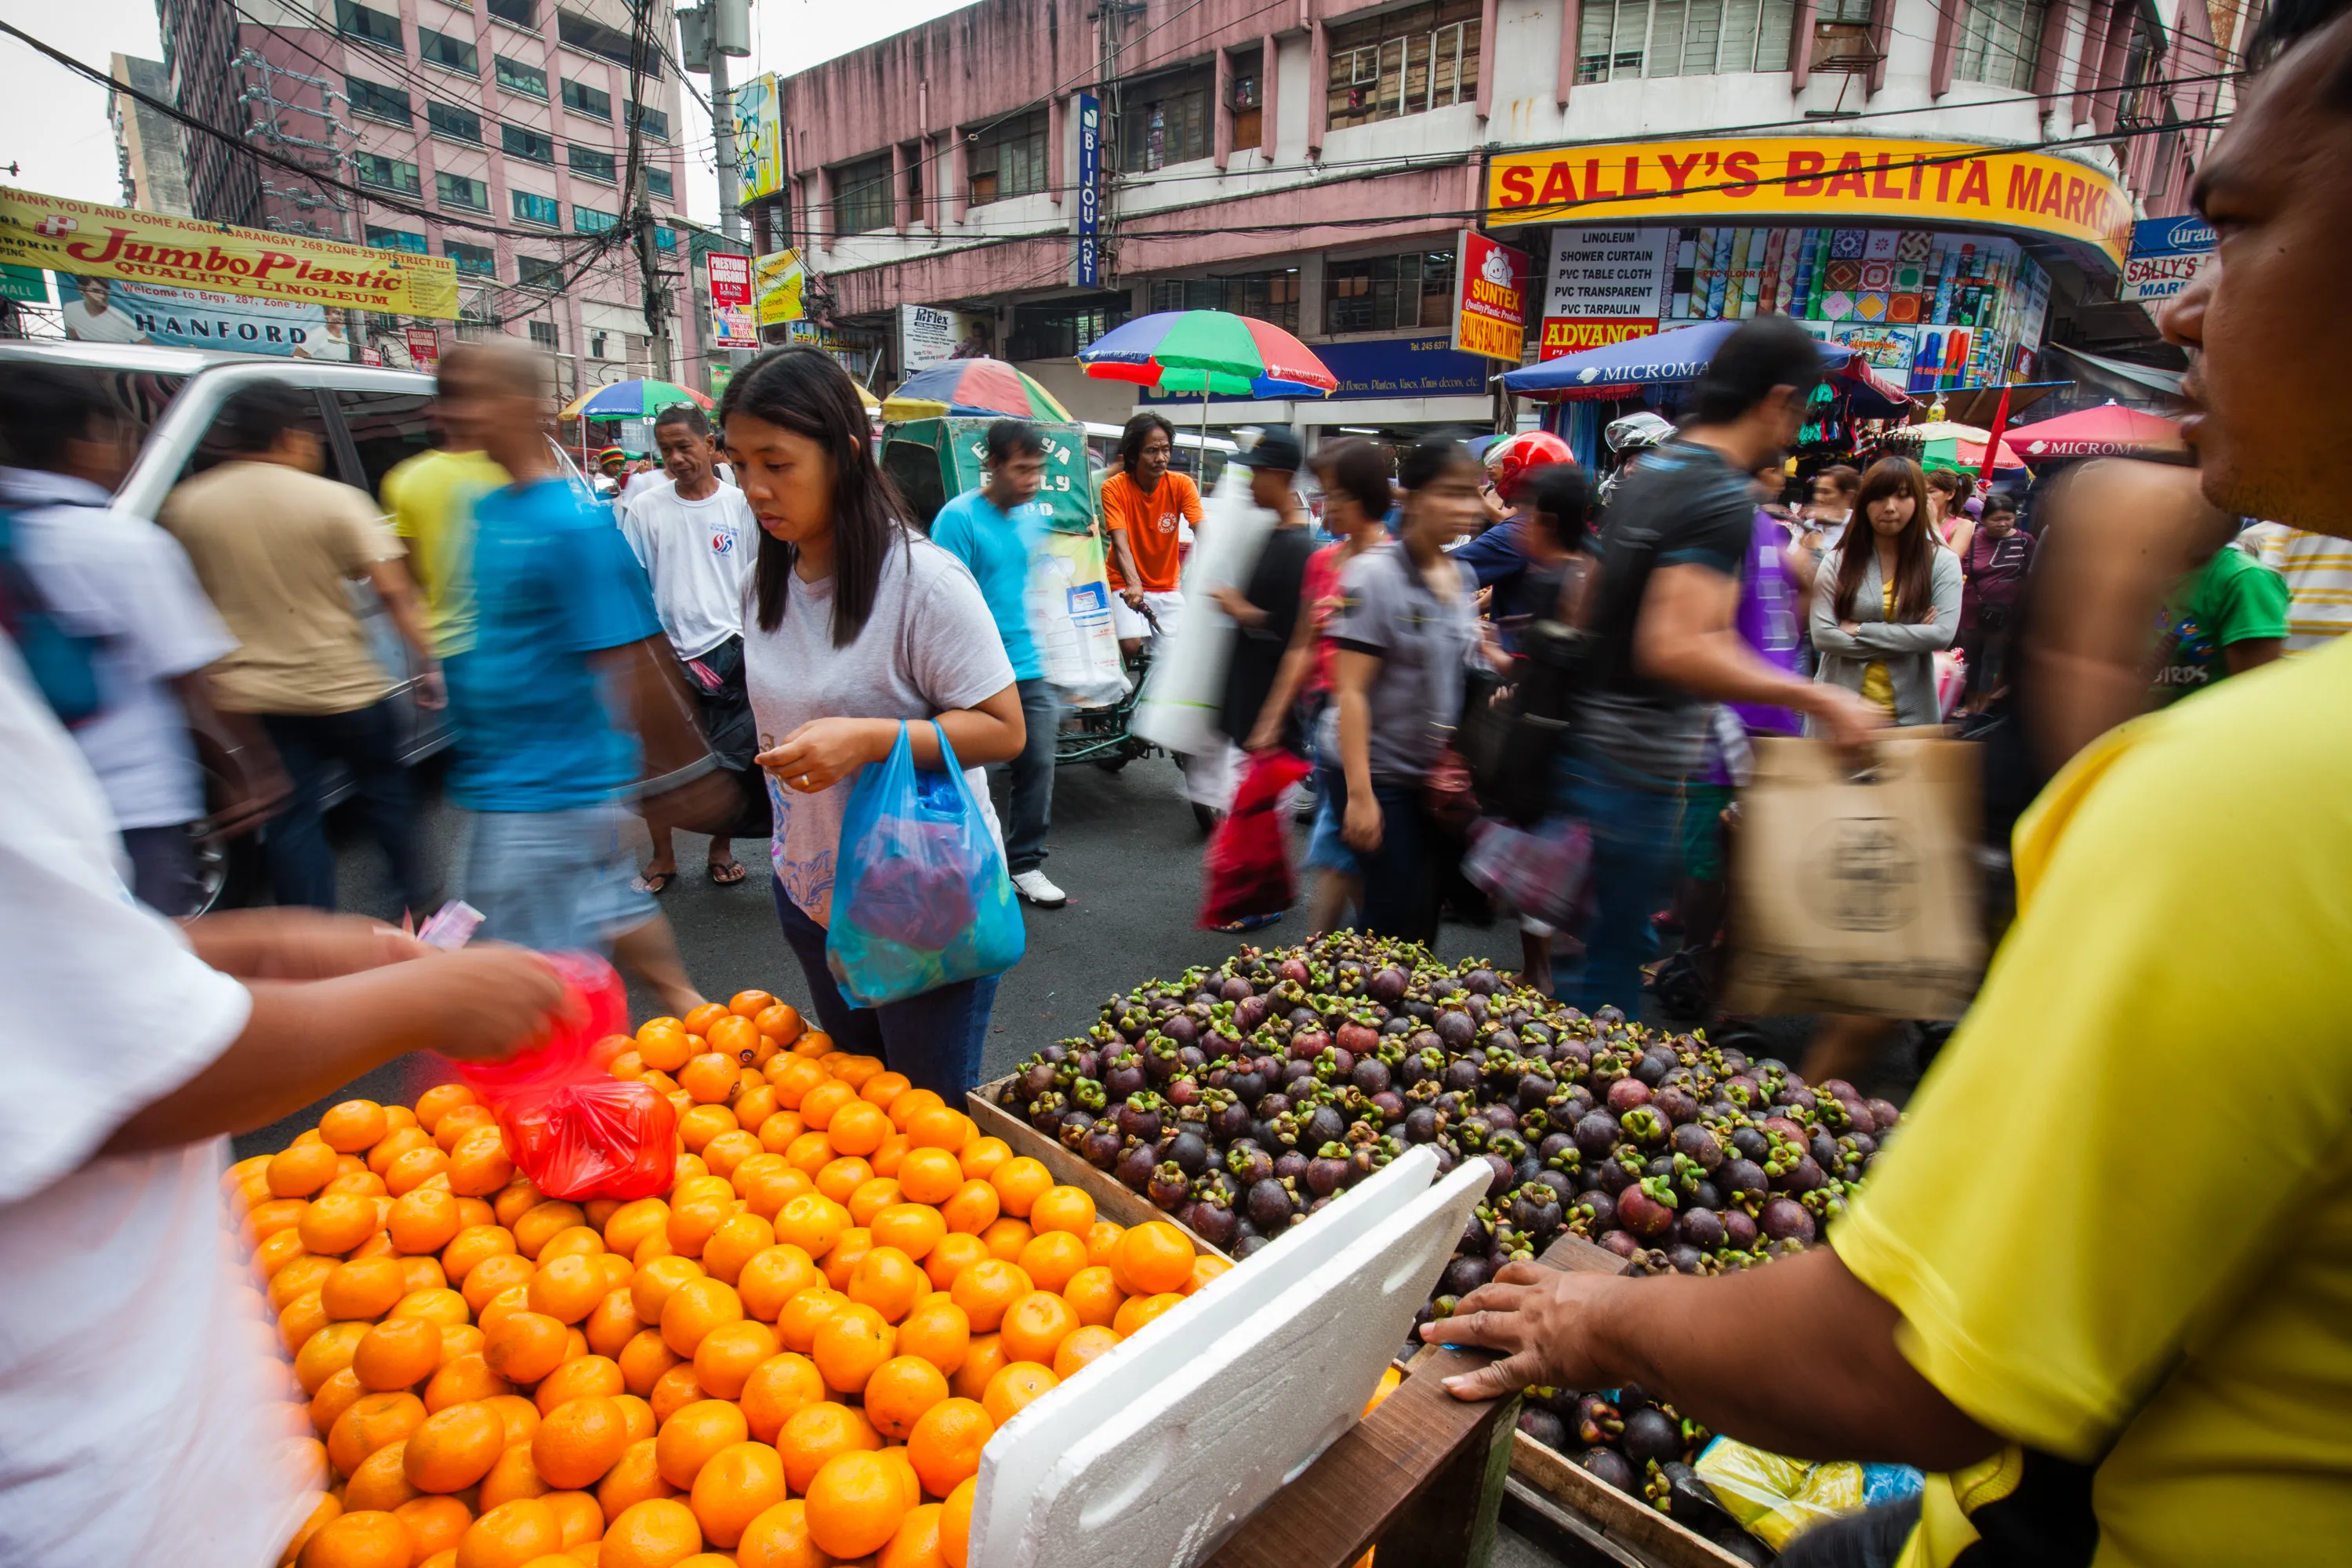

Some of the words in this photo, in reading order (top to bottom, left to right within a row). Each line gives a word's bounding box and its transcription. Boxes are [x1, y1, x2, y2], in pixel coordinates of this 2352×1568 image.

[1083, 132, 1095, 223] BIJOU
[1498, 151, 1760, 209] SALLY'S
[1784, 151, 1991, 206] BALITA
[56, 200, 89, 214] YOU
[95, 207, 126, 220] AND
[132, 212, 172, 228] COME
[177, 221, 223, 235] AGAIN
[227, 227, 296, 248] BARANGAY
[301, 240, 323, 251] 268
[326, 244, 358, 256] ZONE
[362, 249, 375, 259] 25
[379, 252, 432, 267] DISTRICT
[435, 260, 451, 270] III
[1582, 233, 1635, 243] LINOLEUM
[710, 256, 747, 271] PRESYONG
[1560, 251, 1604, 261] SHOWER
[1606, 250, 1653, 261] CURTAIN
[712, 269, 747, 284] DIVISORIA
[1559, 269, 1579, 280] PVC
[1582, 269, 1614, 279] TABLE
[1617, 269, 1653, 279] CLOTH
[2127, 256, 2198, 282] SALLY'S
[114, 263, 245, 286] QUALITY
[255, 280, 390, 305] LINOLEUM
[1555, 287, 1574, 297] PVC
[1577, 287, 1653, 297] TRANSPARENT
[122, 282, 178, 298] Welcome
[183, 290, 195, 299] to
[200, 292, 230, 304] Brgy.
[235, 295, 259, 307] 287,
[264, 298, 290, 308] Zone
[1472, 278, 1520, 312] SUNTEX
[1465, 299, 1485, 314] Quality
[1484, 303, 1501, 318] Plastic
[1501, 309, 1522, 324] Products
[1561, 304, 1581, 314] PVC
[1584, 304, 1641, 314] TARPAULIN
[134, 314, 308, 344] HANFORD
[1544, 323, 1653, 347] ADVANCE
[1410, 343, 1420, 351] Tel.
[1421, 342, 1433, 350] 245
[1434, 341, 1449, 350] 6371
[1282, 366, 1327, 383] MICROMATIC
[1602, 361, 1710, 382] MICROMA
[1346, 379, 1370, 391] Flowers,
[1371, 379, 1398, 391] Planters,
[1399, 378, 1419, 390] Vases,
[1439, 376, 1464, 388] decors,
[1465, 376, 1480, 387] etc.
[2050, 442, 2144, 456] MICROMA
